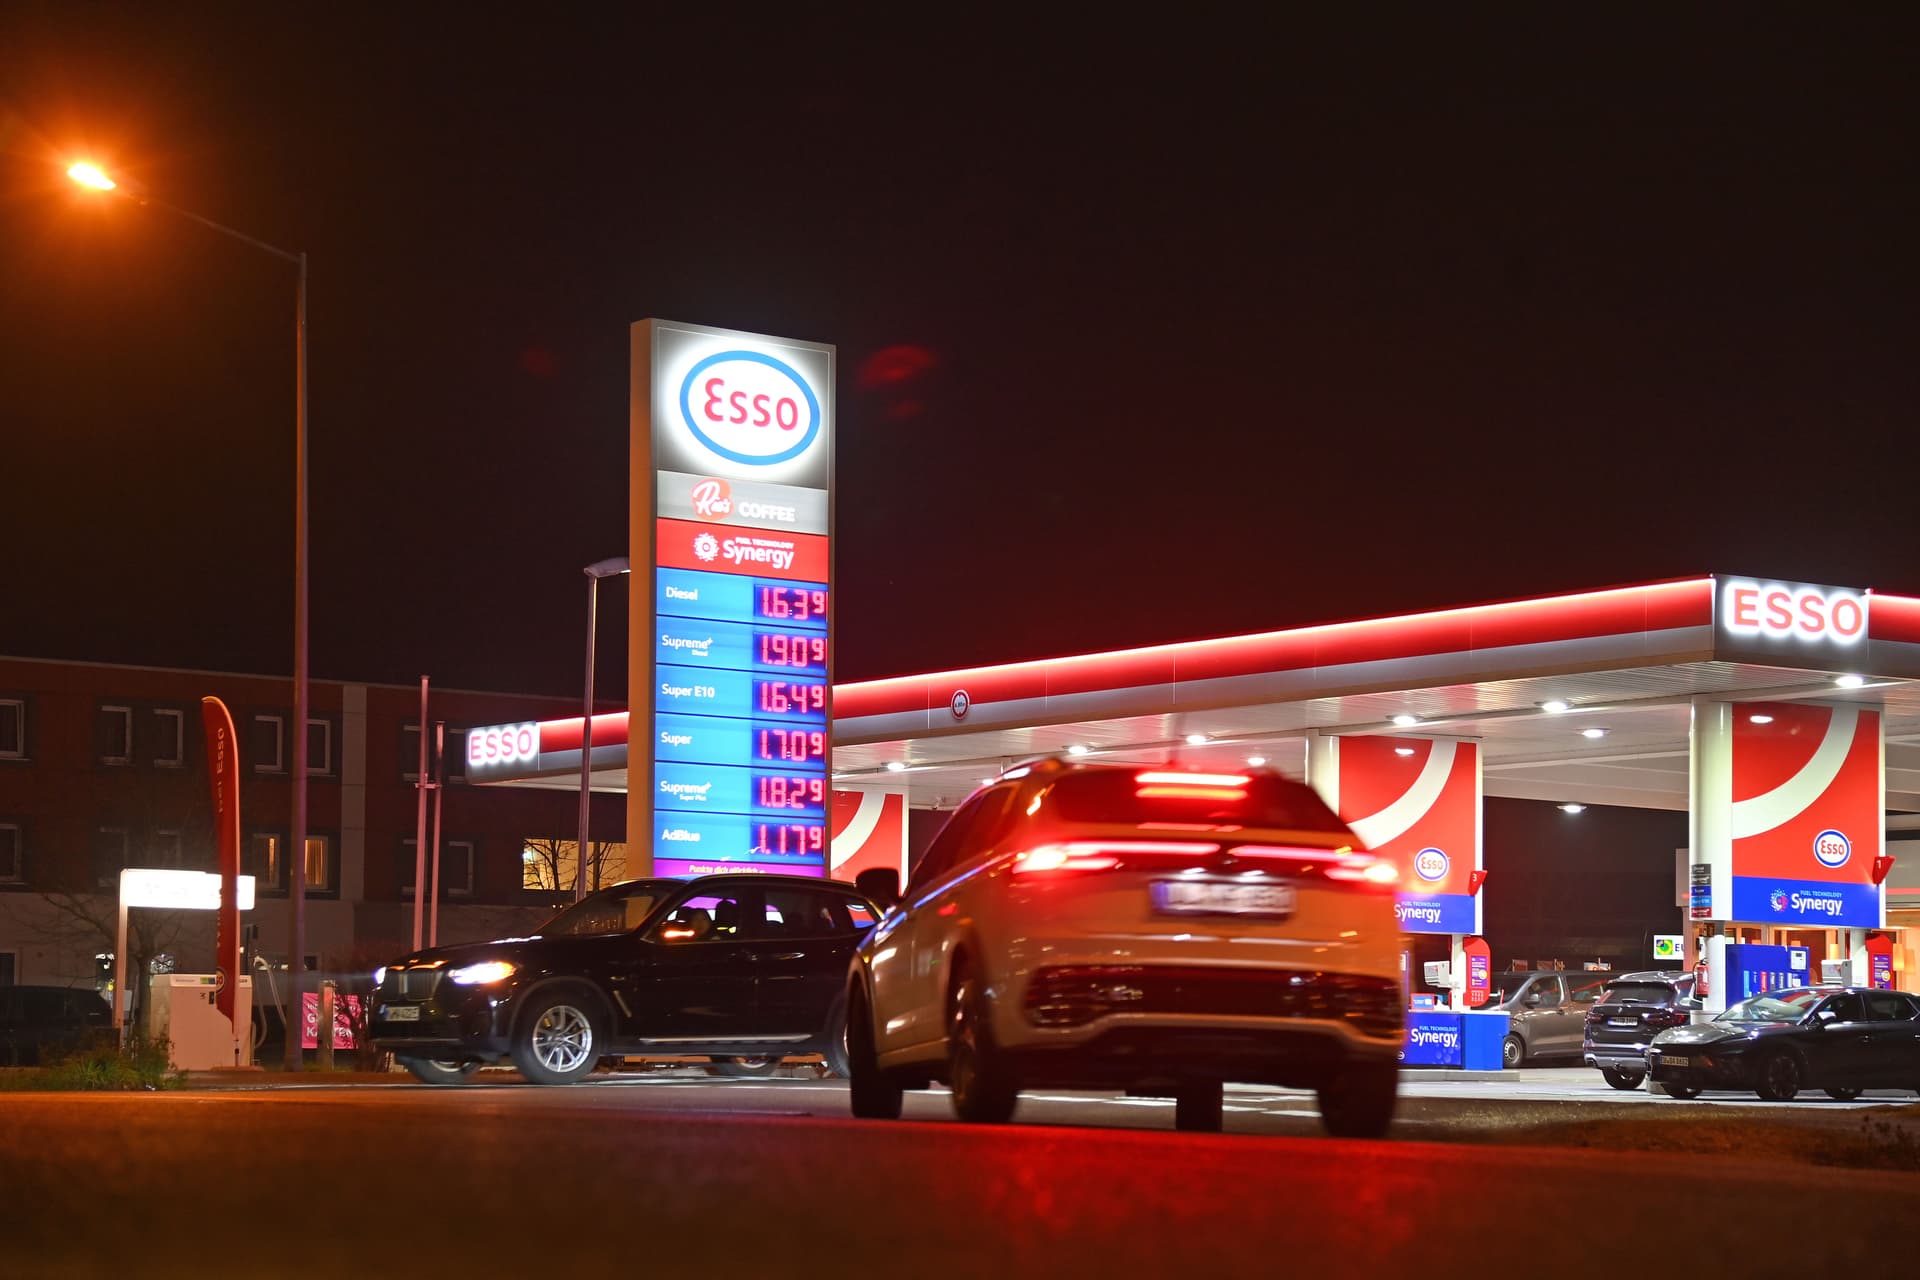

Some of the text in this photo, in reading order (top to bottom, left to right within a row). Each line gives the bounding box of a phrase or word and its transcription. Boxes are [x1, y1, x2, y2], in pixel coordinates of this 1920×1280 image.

[738, 501, 796, 522] COFFEE
[722, 539, 795, 570] Synergy
[665, 586, 699, 601] Diesel
[1734, 588, 1863, 637] ESSO
[661, 683, 692, 698] Super
[694, 685, 715, 697] E10
[470, 729, 532, 760] ESSO
[660, 731, 692, 746] Super
[661, 829, 701, 842] AdBlue
[1876, 860, 1882, 869] 1
[1472, 873, 1478, 882] 3
[1394, 904, 1441, 923] Synergy
[1791, 893, 1842, 916] Synergy
[1411, 1028, 1458, 1047] Synergy
